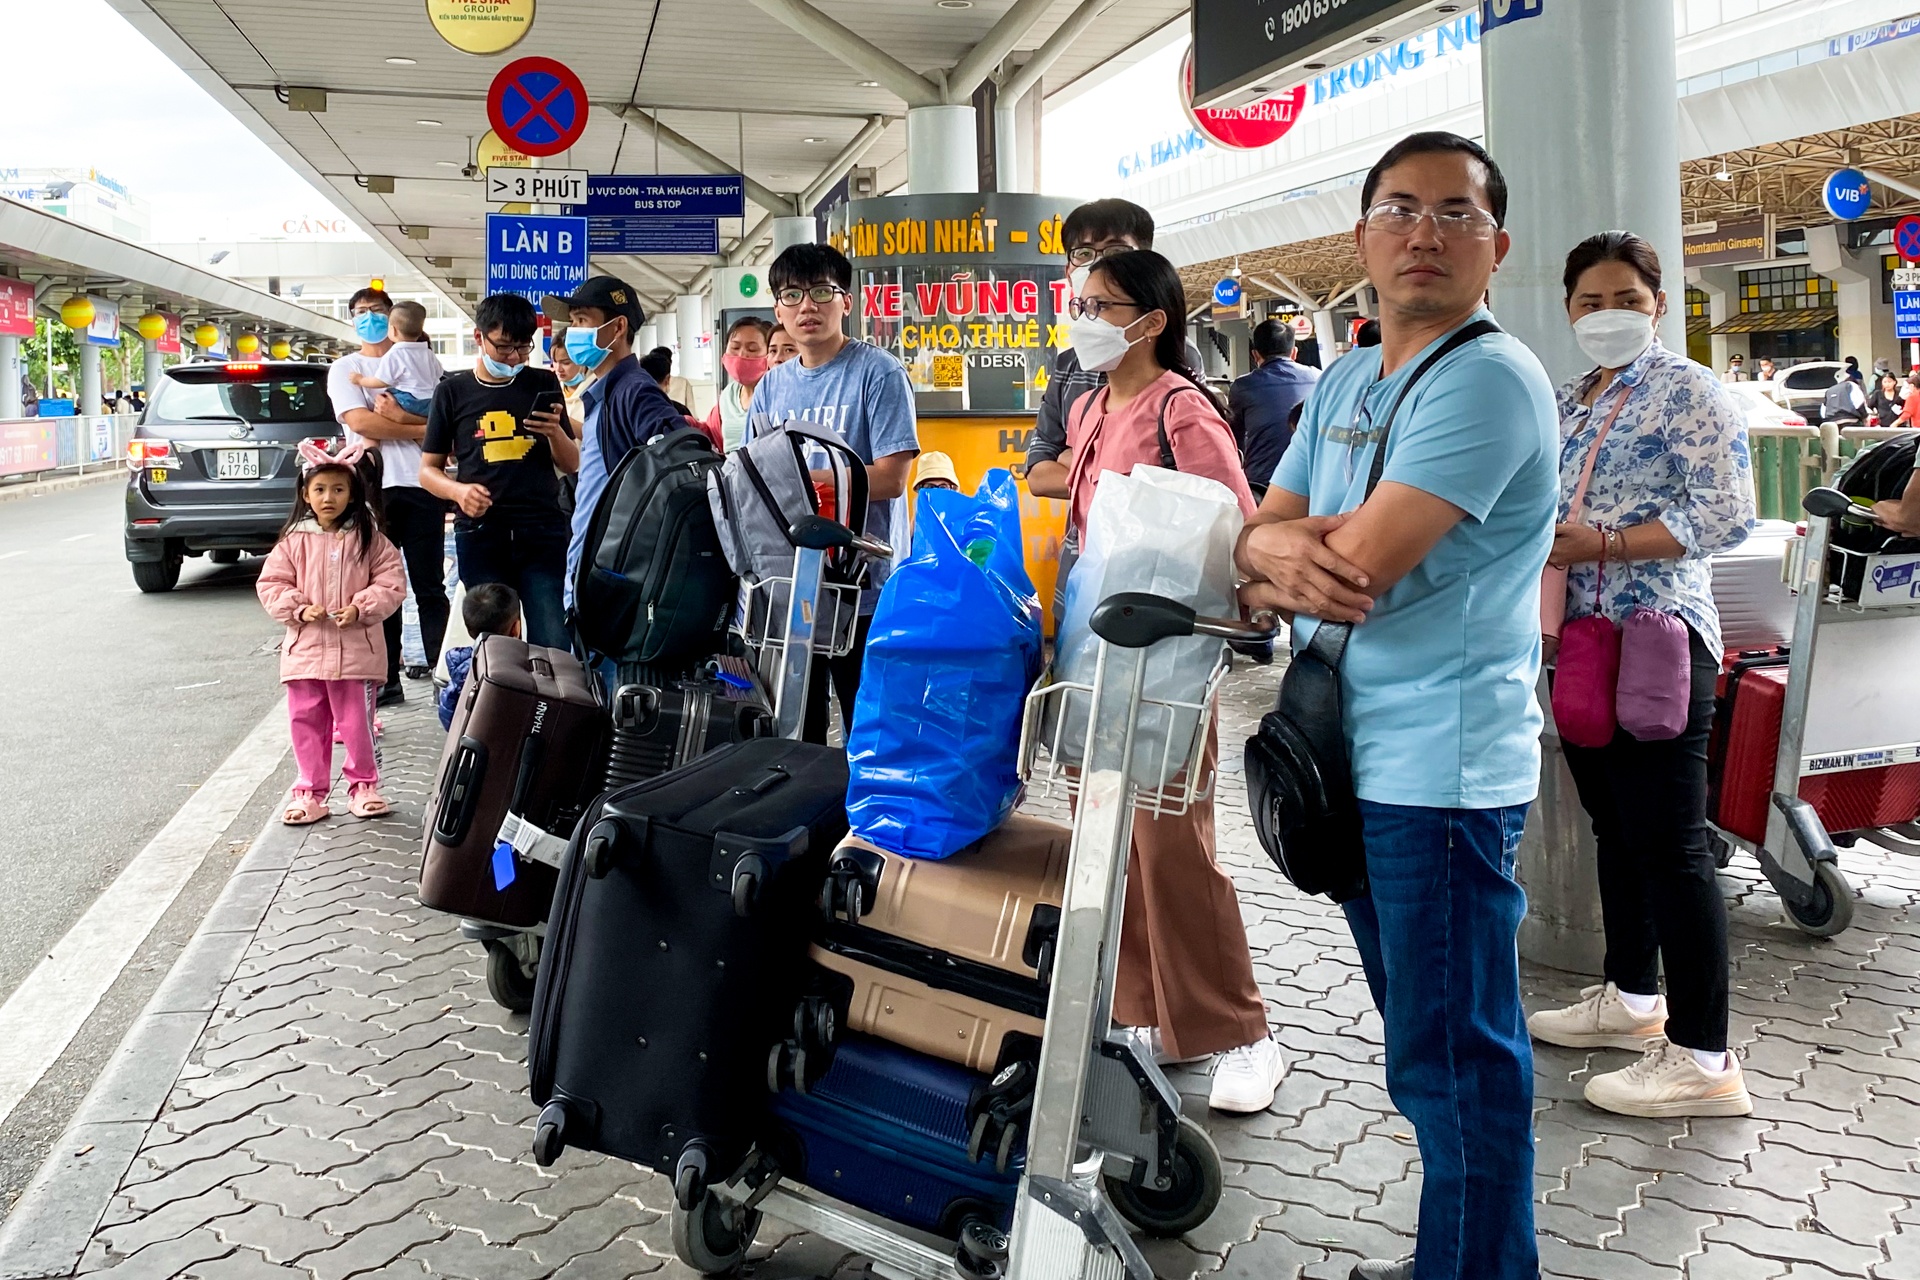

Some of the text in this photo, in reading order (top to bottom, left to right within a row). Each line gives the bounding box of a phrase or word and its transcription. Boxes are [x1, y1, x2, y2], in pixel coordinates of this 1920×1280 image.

[463, 4, 499, 13] GROUP
[1281, 1, 1311, 35] 1900
[1207, 103, 1293, 122] GENERALI
[515, 178, 525, 196] 3
[533, 175, 581, 198] PHÚT
[596, 186, 616, 197] VỰC
[618, 185, 639, 195] ĐÓN
[667, 184, 699, 195] KHÁCH
[701, 186, 713, 195] XE
[715, 185, 740, 195] BUÝT
[1835, 187, 1860, 202] VIB
[635, 200, 682, 209] BUS STOP
[282, 214, 346, 234] CẢNG
[851, 218, 878, 258] TÂN
[883, 217, 927, 255] SƠN
[934, 207, 998, 253] NHẤT
[502, 222, 548, 254] LÀN
[558, 231, 573, 254] B
[1684, 237, 1763, 256] Homtamin Ginseng
[490, 260, 583, 284] NƠI DỪNG CHỜ TẠM
[863, 284, 904, 319] XE
[916, 271, 1039, 318] VŨNG
[1218, 289, 1235, 297] VIB
[902, 325, 960, 349] CHO
[968, 319, 1040, 349] THUÊ
[1046, 325, 1071, 349] XE
[981, 355, 1025, 369] DESK
[227, 452, 249, 464] 51A
[531, 700, 548, 734] THANH
[1809, 754, 1855, 770] BIZMAN.VN
